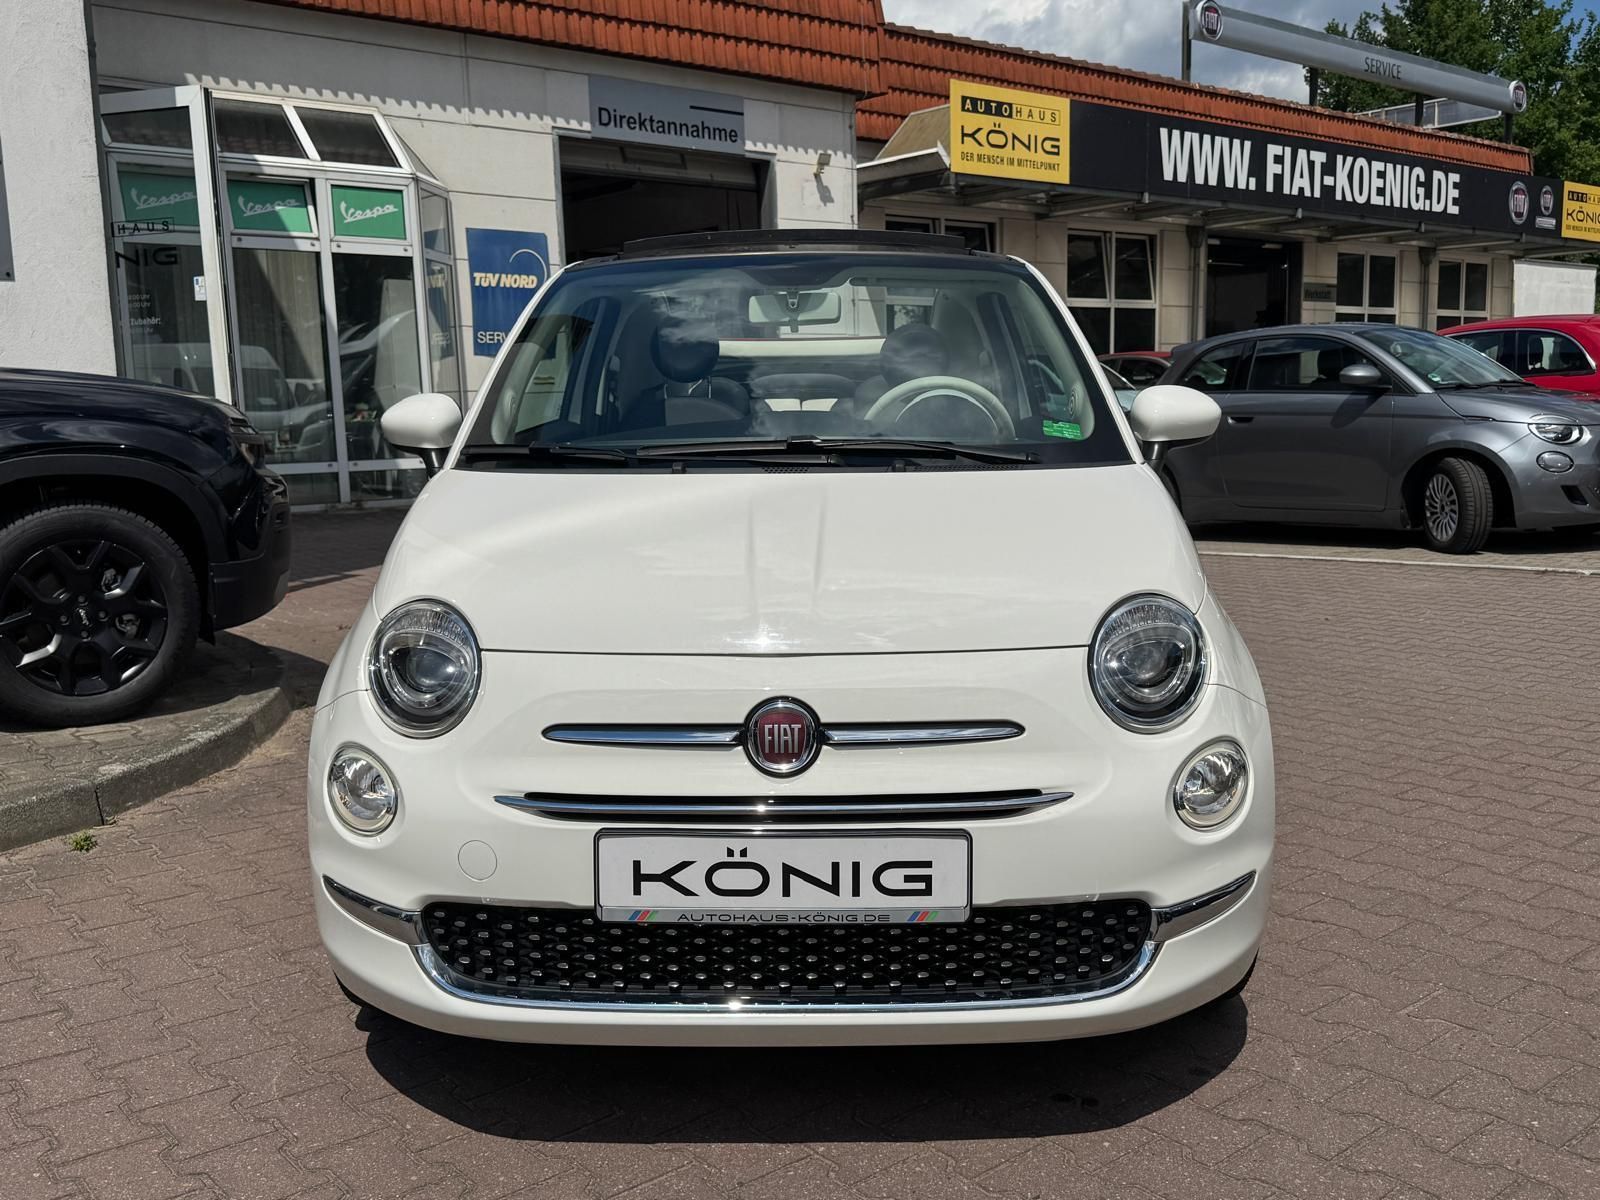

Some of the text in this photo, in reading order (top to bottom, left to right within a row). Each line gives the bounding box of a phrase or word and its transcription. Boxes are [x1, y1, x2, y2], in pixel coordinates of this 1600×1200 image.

[1364, 57, 1401, 80] SERVICE
[597, 106, 739, 143] Direktannahme
[960, 122, 1061, 157] KÖNIG
[960, 151, 1061, 173] DER MENSCH IM MITTELPUNKT
[1159, 127, 1461, 215] WWW. FIAT-KOENIG.DE
[131, 187, 197, 210] Vespa
[237, 195, 301, 217] Vespa
[339, 200, 399, 224] Vespa
[117, 220, 170, 235] HAUS
[115, 246, 178, 268] NIG
[473, 272, 538, 289] TÜV NORD
[764, 723, 802, 754] FIAT
[632, 846, 933, 898] KÖNIG
[677, 911, 891, 923] AUTOHAUS-KÖNIG.DE
